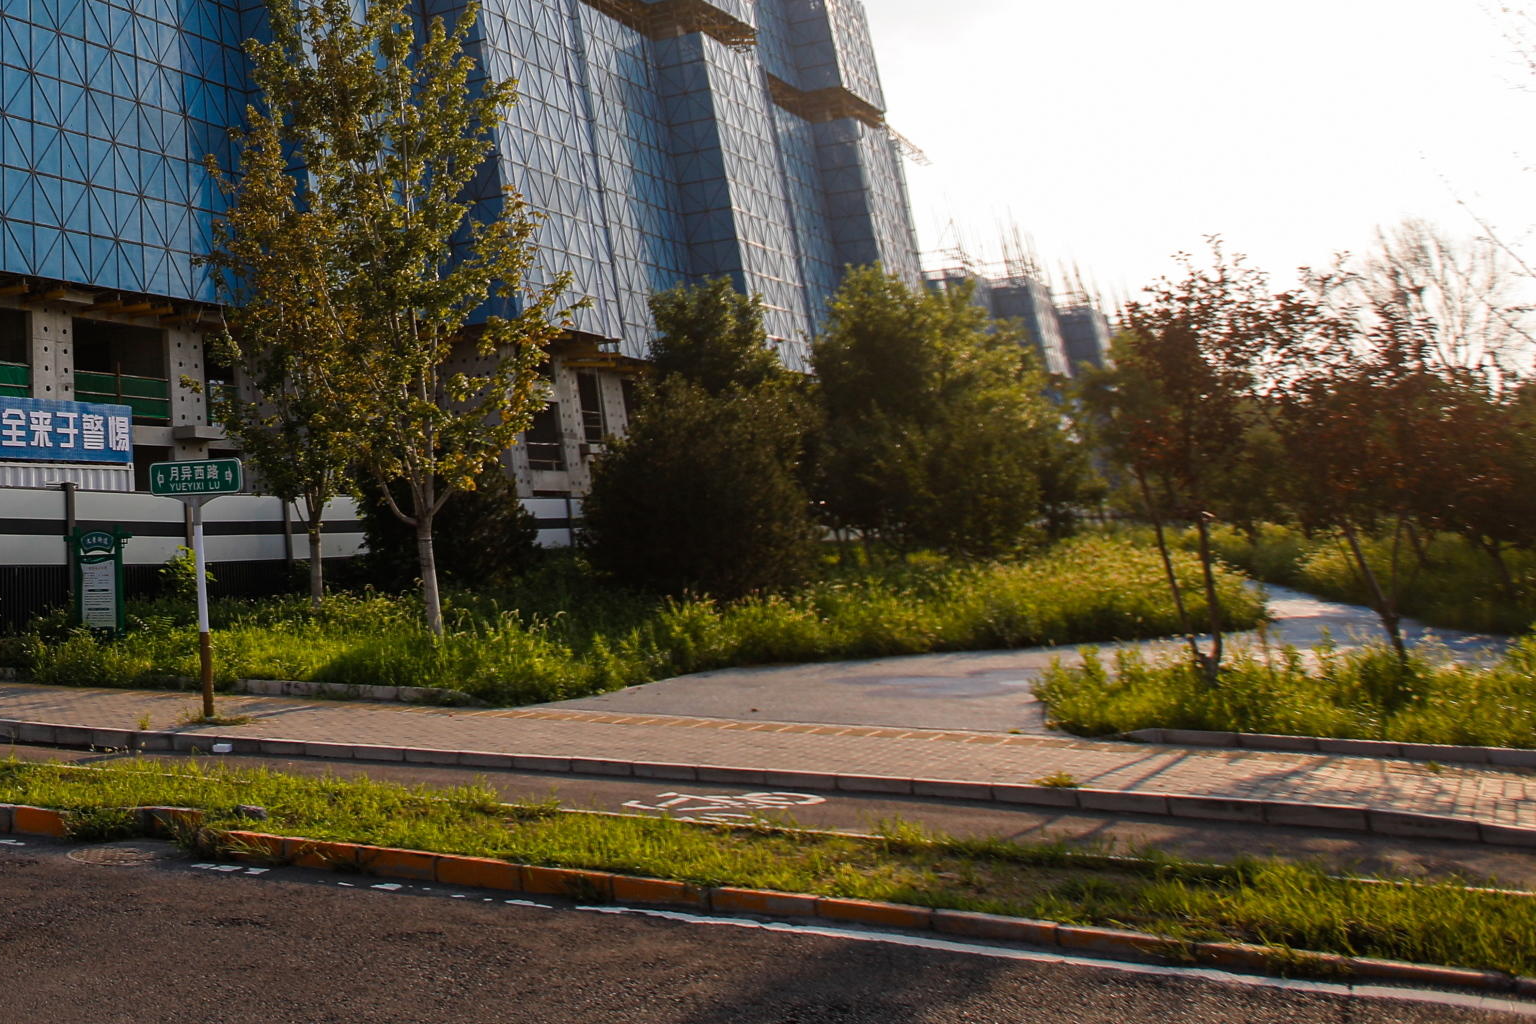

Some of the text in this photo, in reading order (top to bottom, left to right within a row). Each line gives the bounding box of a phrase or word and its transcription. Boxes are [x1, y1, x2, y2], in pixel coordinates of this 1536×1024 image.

[170, 464, 219, 481] 月异西路
[170, 480, 220, 491] YUEYIXI LU
